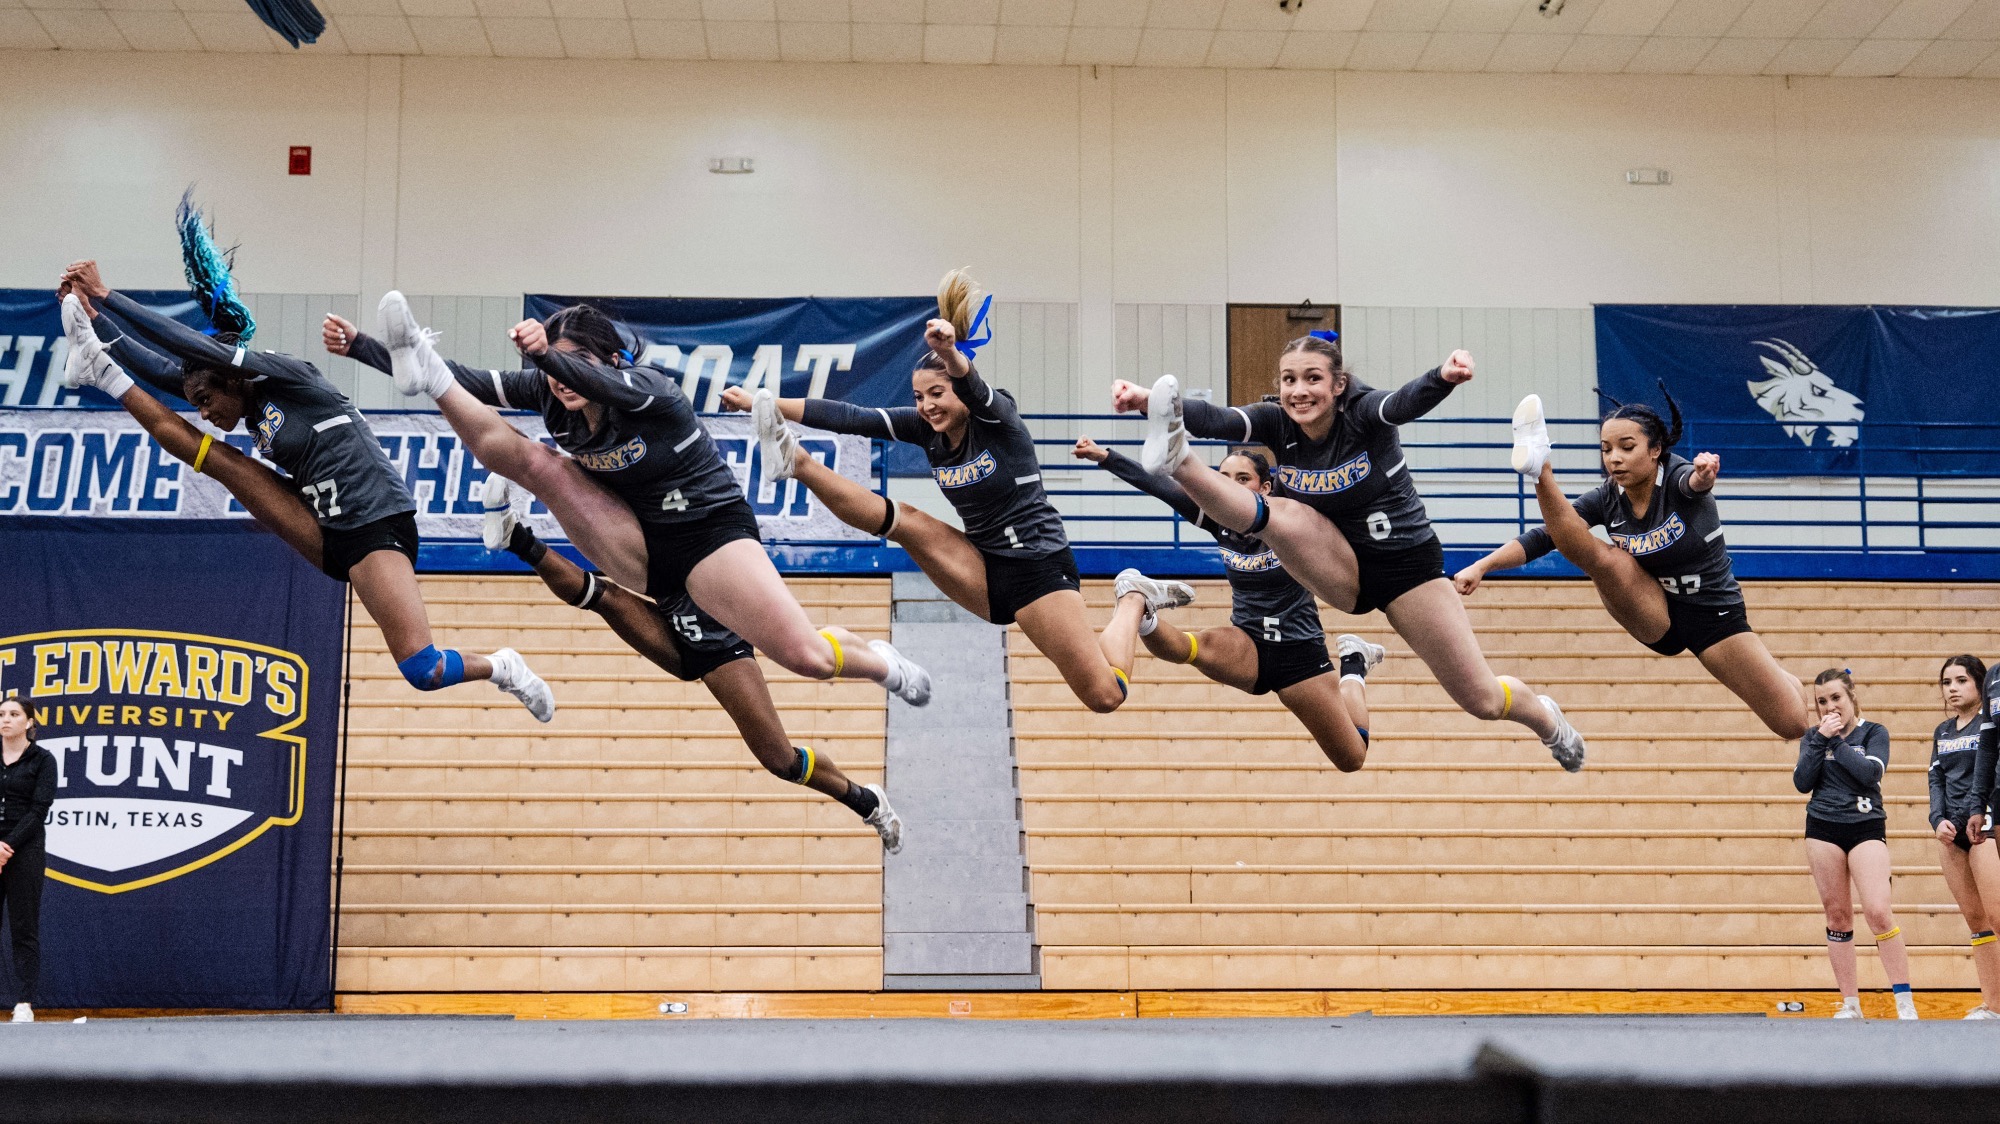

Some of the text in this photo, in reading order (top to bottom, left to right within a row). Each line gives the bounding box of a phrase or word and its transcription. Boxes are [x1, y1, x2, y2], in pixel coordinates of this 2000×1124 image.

[938, 449, 997, 489] MARY'S
[1299, 451, 1371, 494] MARY'S
[662, 488, 690, 511] 4
[1004, 526, 1024, 549] 1
[1628, 511, 1686, 556] MARY'S
[1263, 616, 1281, 642] 5
[31, 640, 297, 717] EDWARD'S
[33, 703, 235, 731] NIVERSITY
[36, 734, 244, 799] TUNT
[1857, 796, 1873, 814] 8
[44, 810, 204, 829] USTIN, TEXAS
